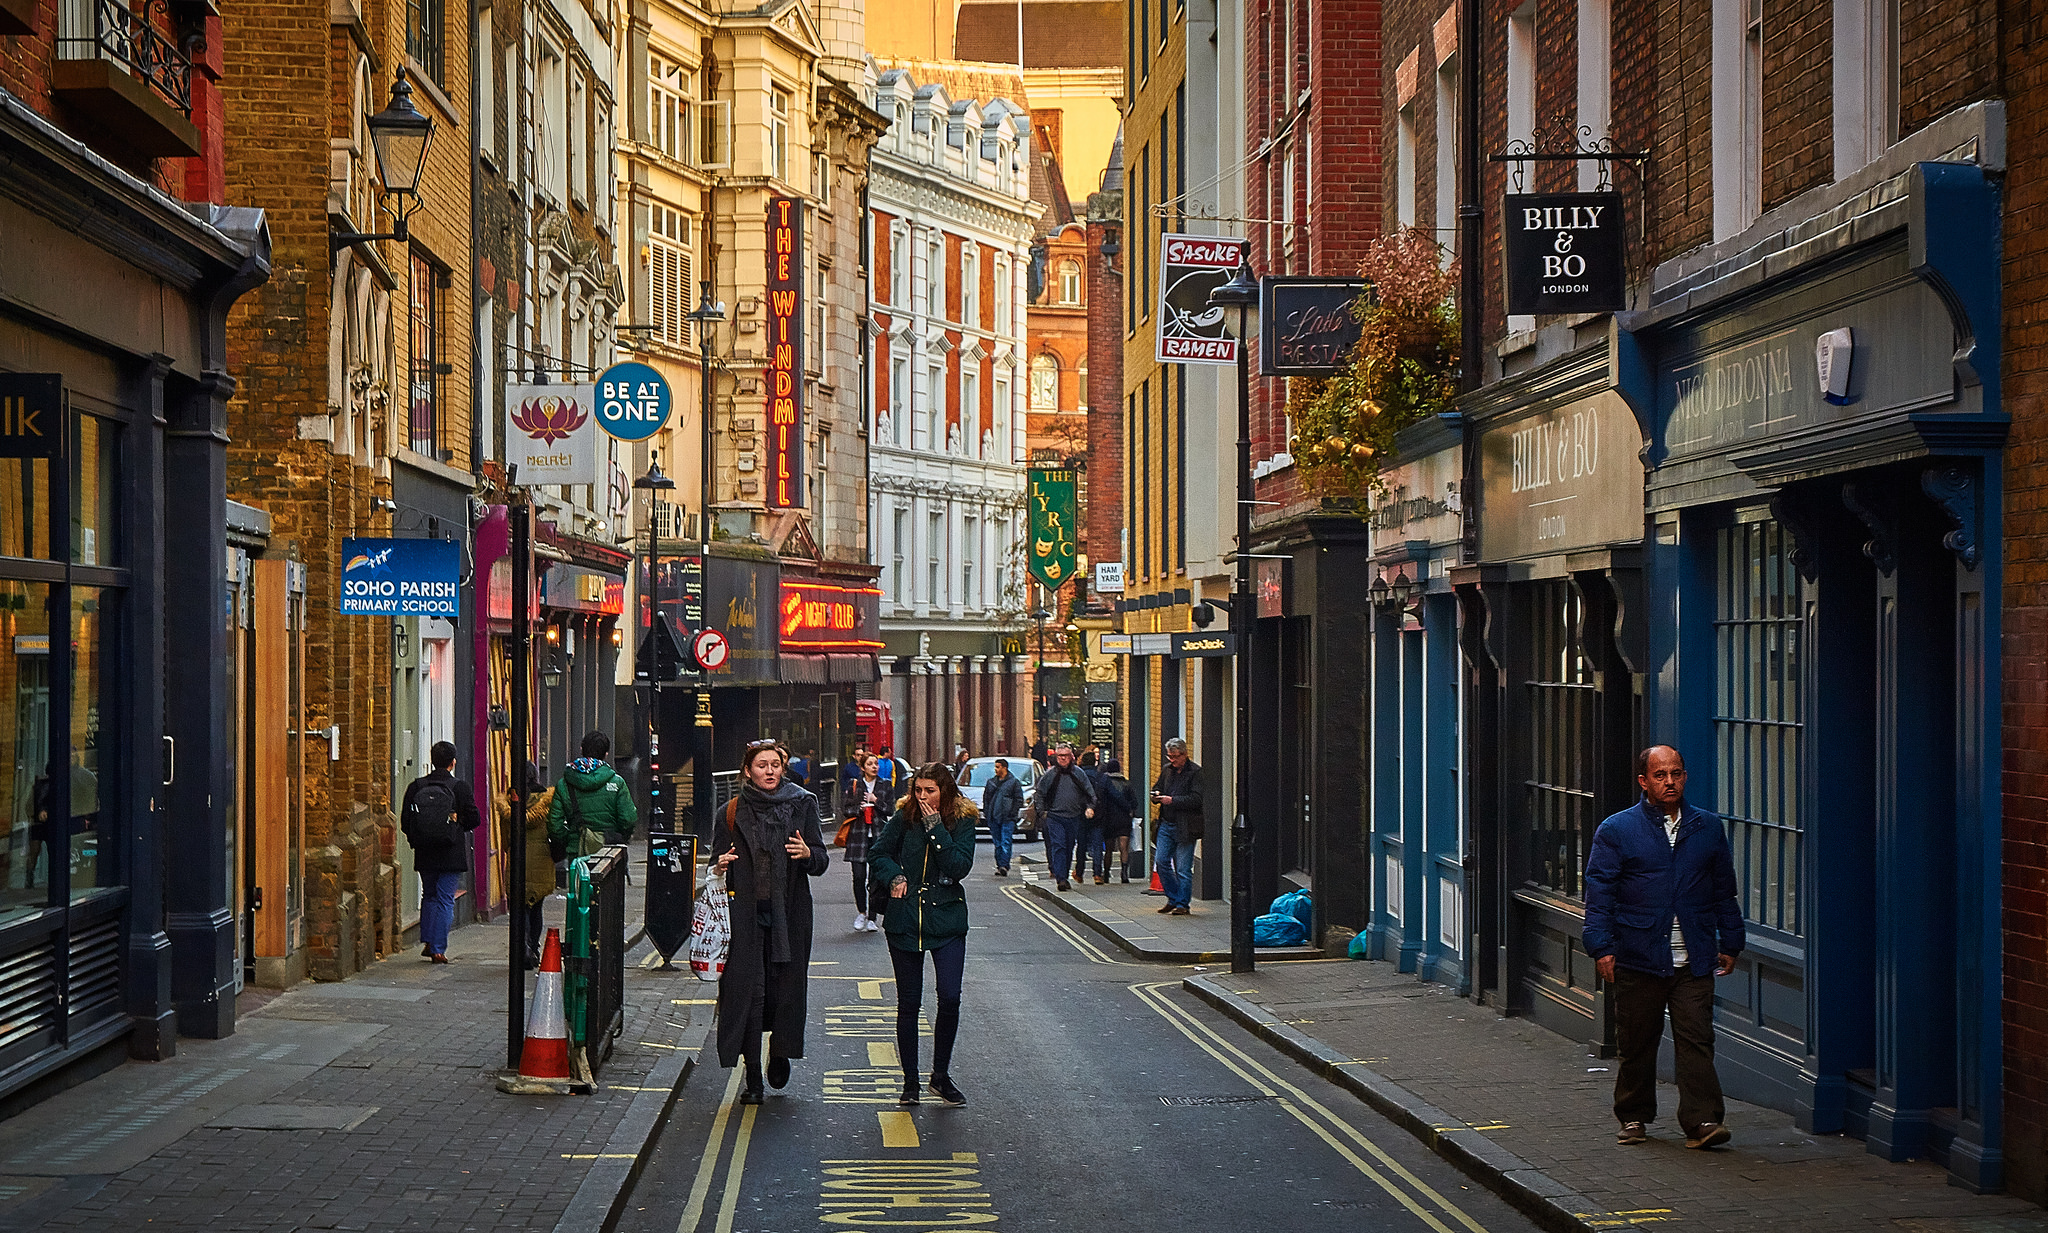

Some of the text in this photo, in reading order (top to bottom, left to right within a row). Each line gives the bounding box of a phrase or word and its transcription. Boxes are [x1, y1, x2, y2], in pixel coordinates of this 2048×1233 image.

[1522, 206, 1605, 231] BILLY
[1553, 231, 1574, 254] &
[1542, 254, 1586, 278] BO
[1542, 284, 1589, 294] LONDON
[772, 200, 796, 506] THE WINDMILL
[1165, 339, 1231, 359] RAMEN
[603, 381, 660, 400] BE AT
[1675, 371, 1712, 422] NICO
[1715, 344, 1793, 411] DIDONNA
[603, 400, 660, 421] ONE
[1511, 407, 1598, 494] BILLY & BO
[1043, 470, 1073, 482] THE
[1032, 481, 1074, 557] LYRIC
[1539, 515, 1566, 540] LONDON
[1101, 566, 1118, 574] HAM
[1101, 574, 1120, 583] YARD
[344, 580, 456, 598] SOHO PARISH
[344, 598, 455, 613] PRIMARY SCHOOL
[1092, 706, 1112, 716] FREE
[1092, 717, 1112, 727] BEER
[818, 1152, 1001, 1233] CHOOL
